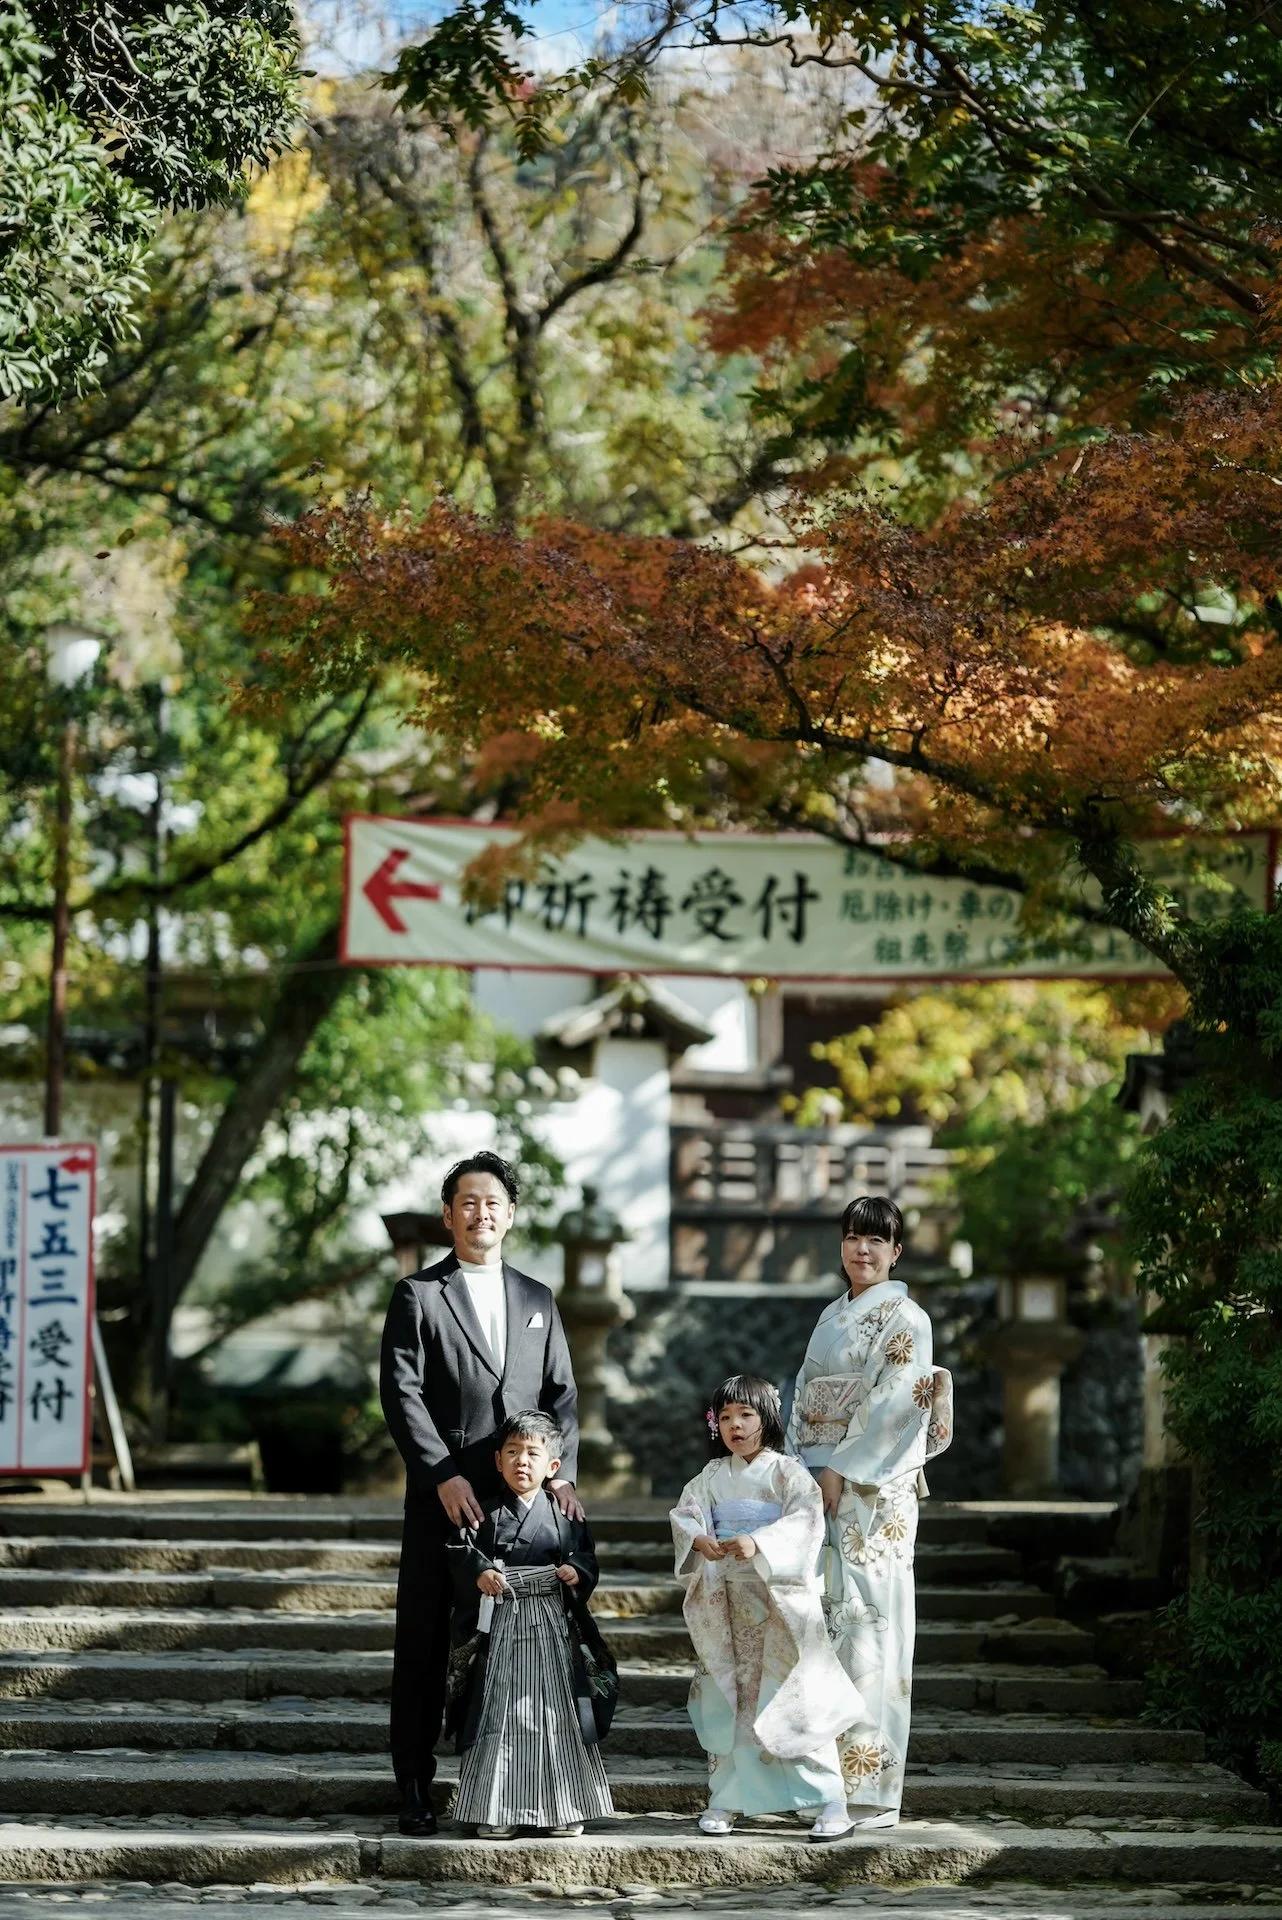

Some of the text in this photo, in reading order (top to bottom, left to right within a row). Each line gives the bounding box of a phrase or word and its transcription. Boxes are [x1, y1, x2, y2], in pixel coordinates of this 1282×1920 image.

[28, 1167, 80, 1424] 七五三受付
